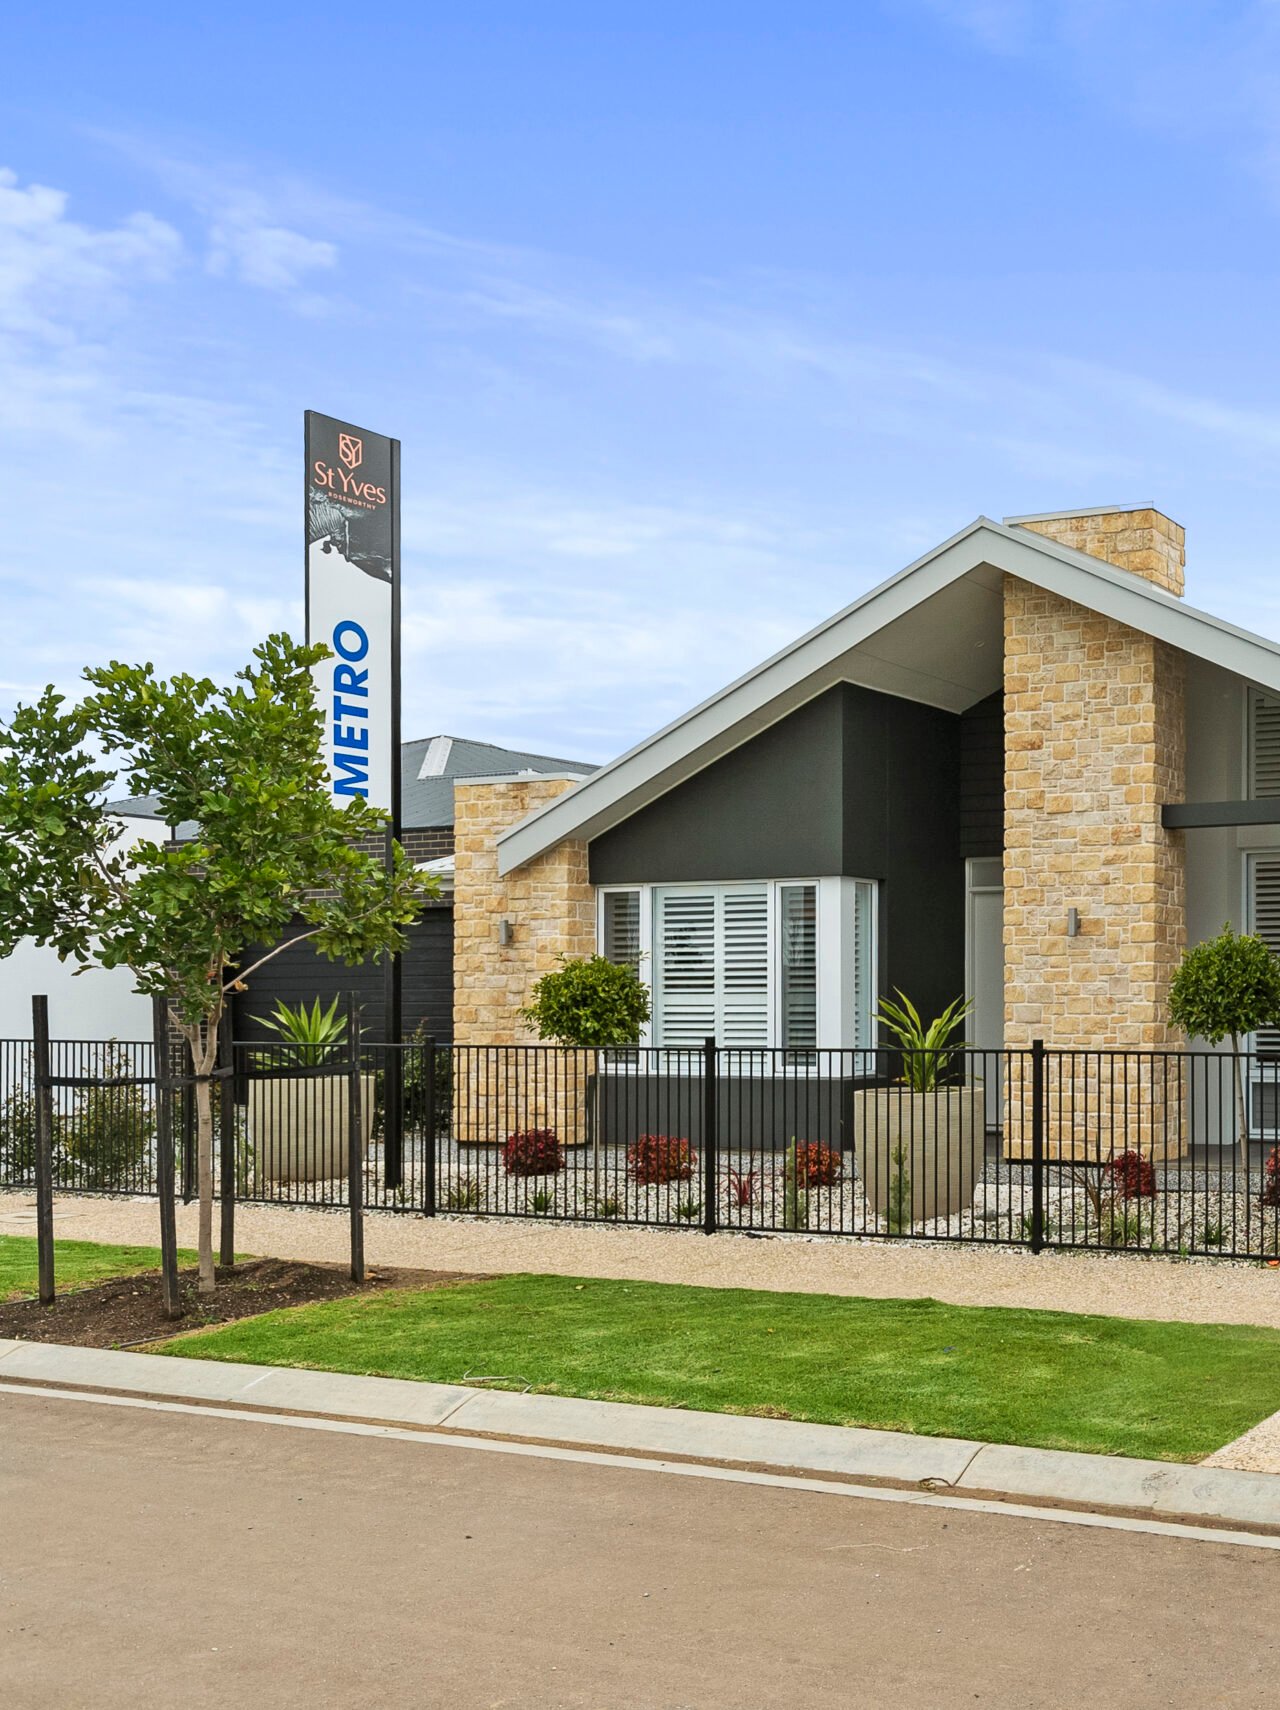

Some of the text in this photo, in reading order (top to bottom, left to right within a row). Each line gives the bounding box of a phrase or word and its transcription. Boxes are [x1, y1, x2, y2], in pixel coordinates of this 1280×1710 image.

[314, 461, 387, 504] St Yves
[328, 491, 377, 510] ROSEWORTHY
[333, 620, 369, 798] METRO
